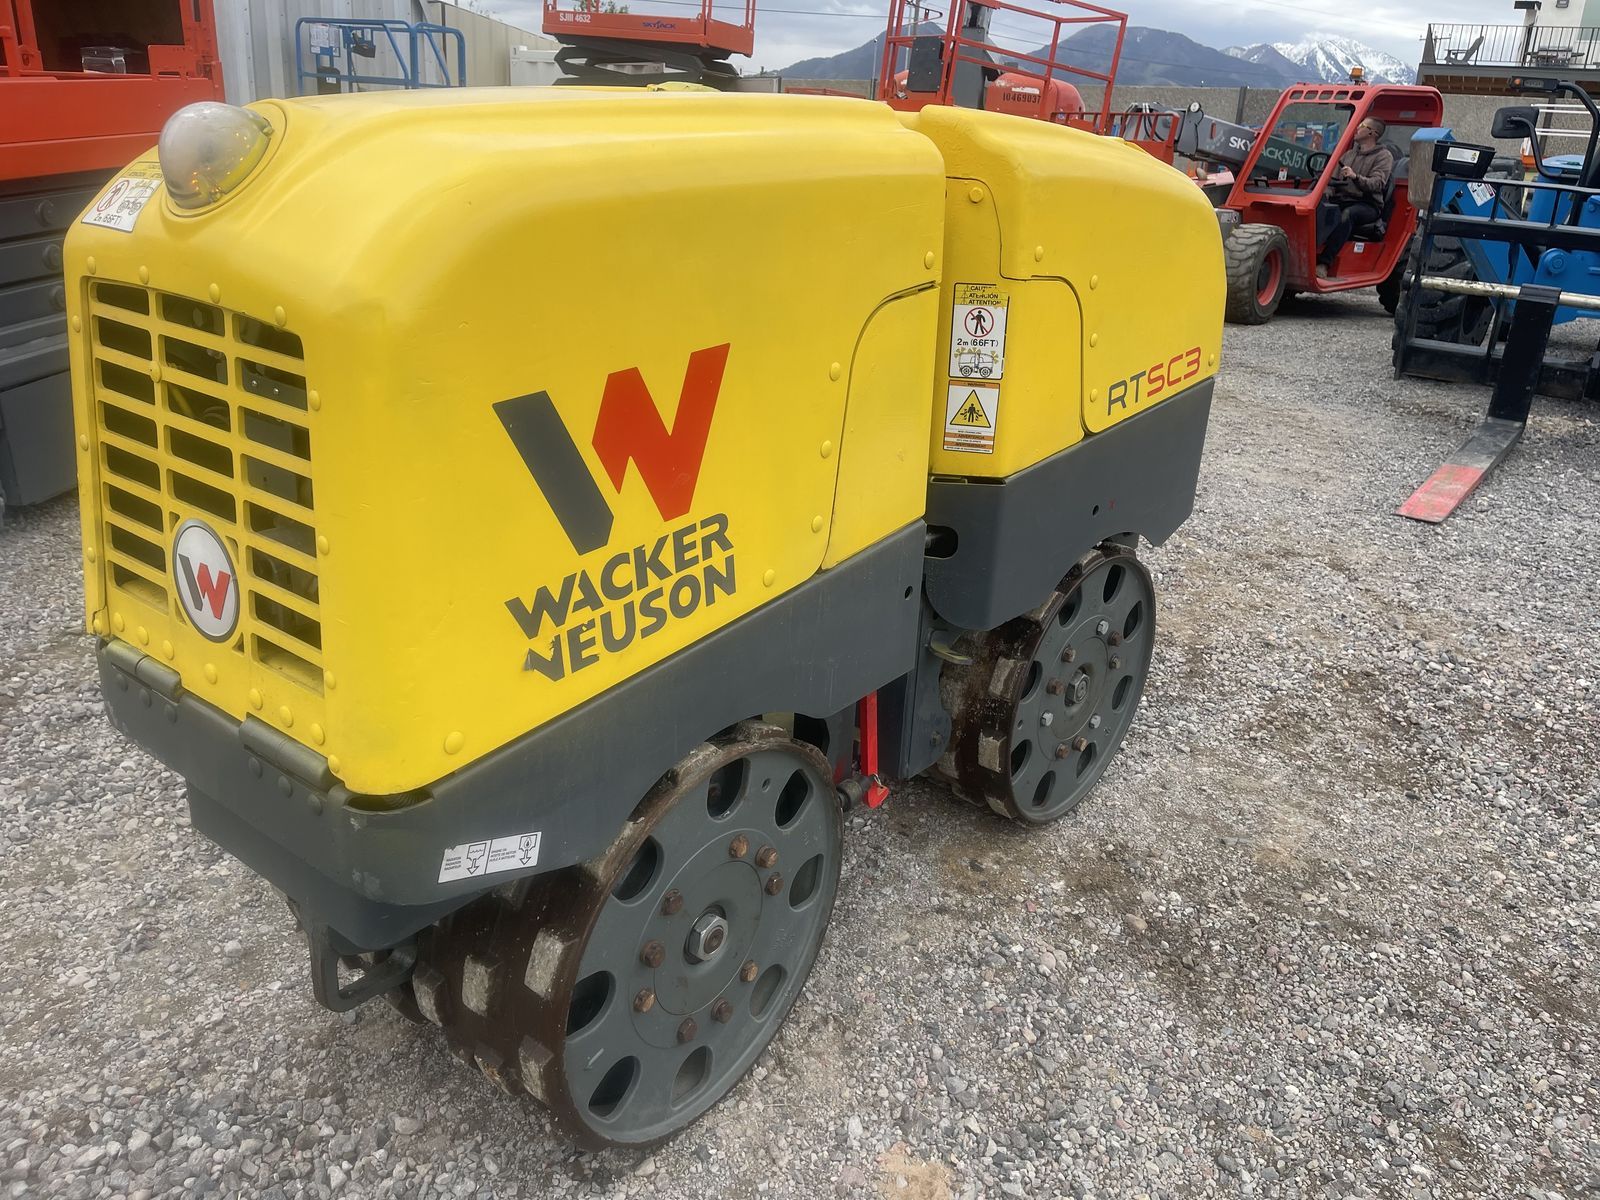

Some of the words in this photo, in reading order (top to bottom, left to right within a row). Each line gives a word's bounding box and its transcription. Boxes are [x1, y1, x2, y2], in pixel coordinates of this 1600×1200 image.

[574, 14, 591, 23] 4632
[1003, 92, 1041, 104] 10469037
[1107, 346, 1202, 416] RTSC3
[504, 512, 735, 640] WACKER
[522, 553, 737, 683] NEUSON
